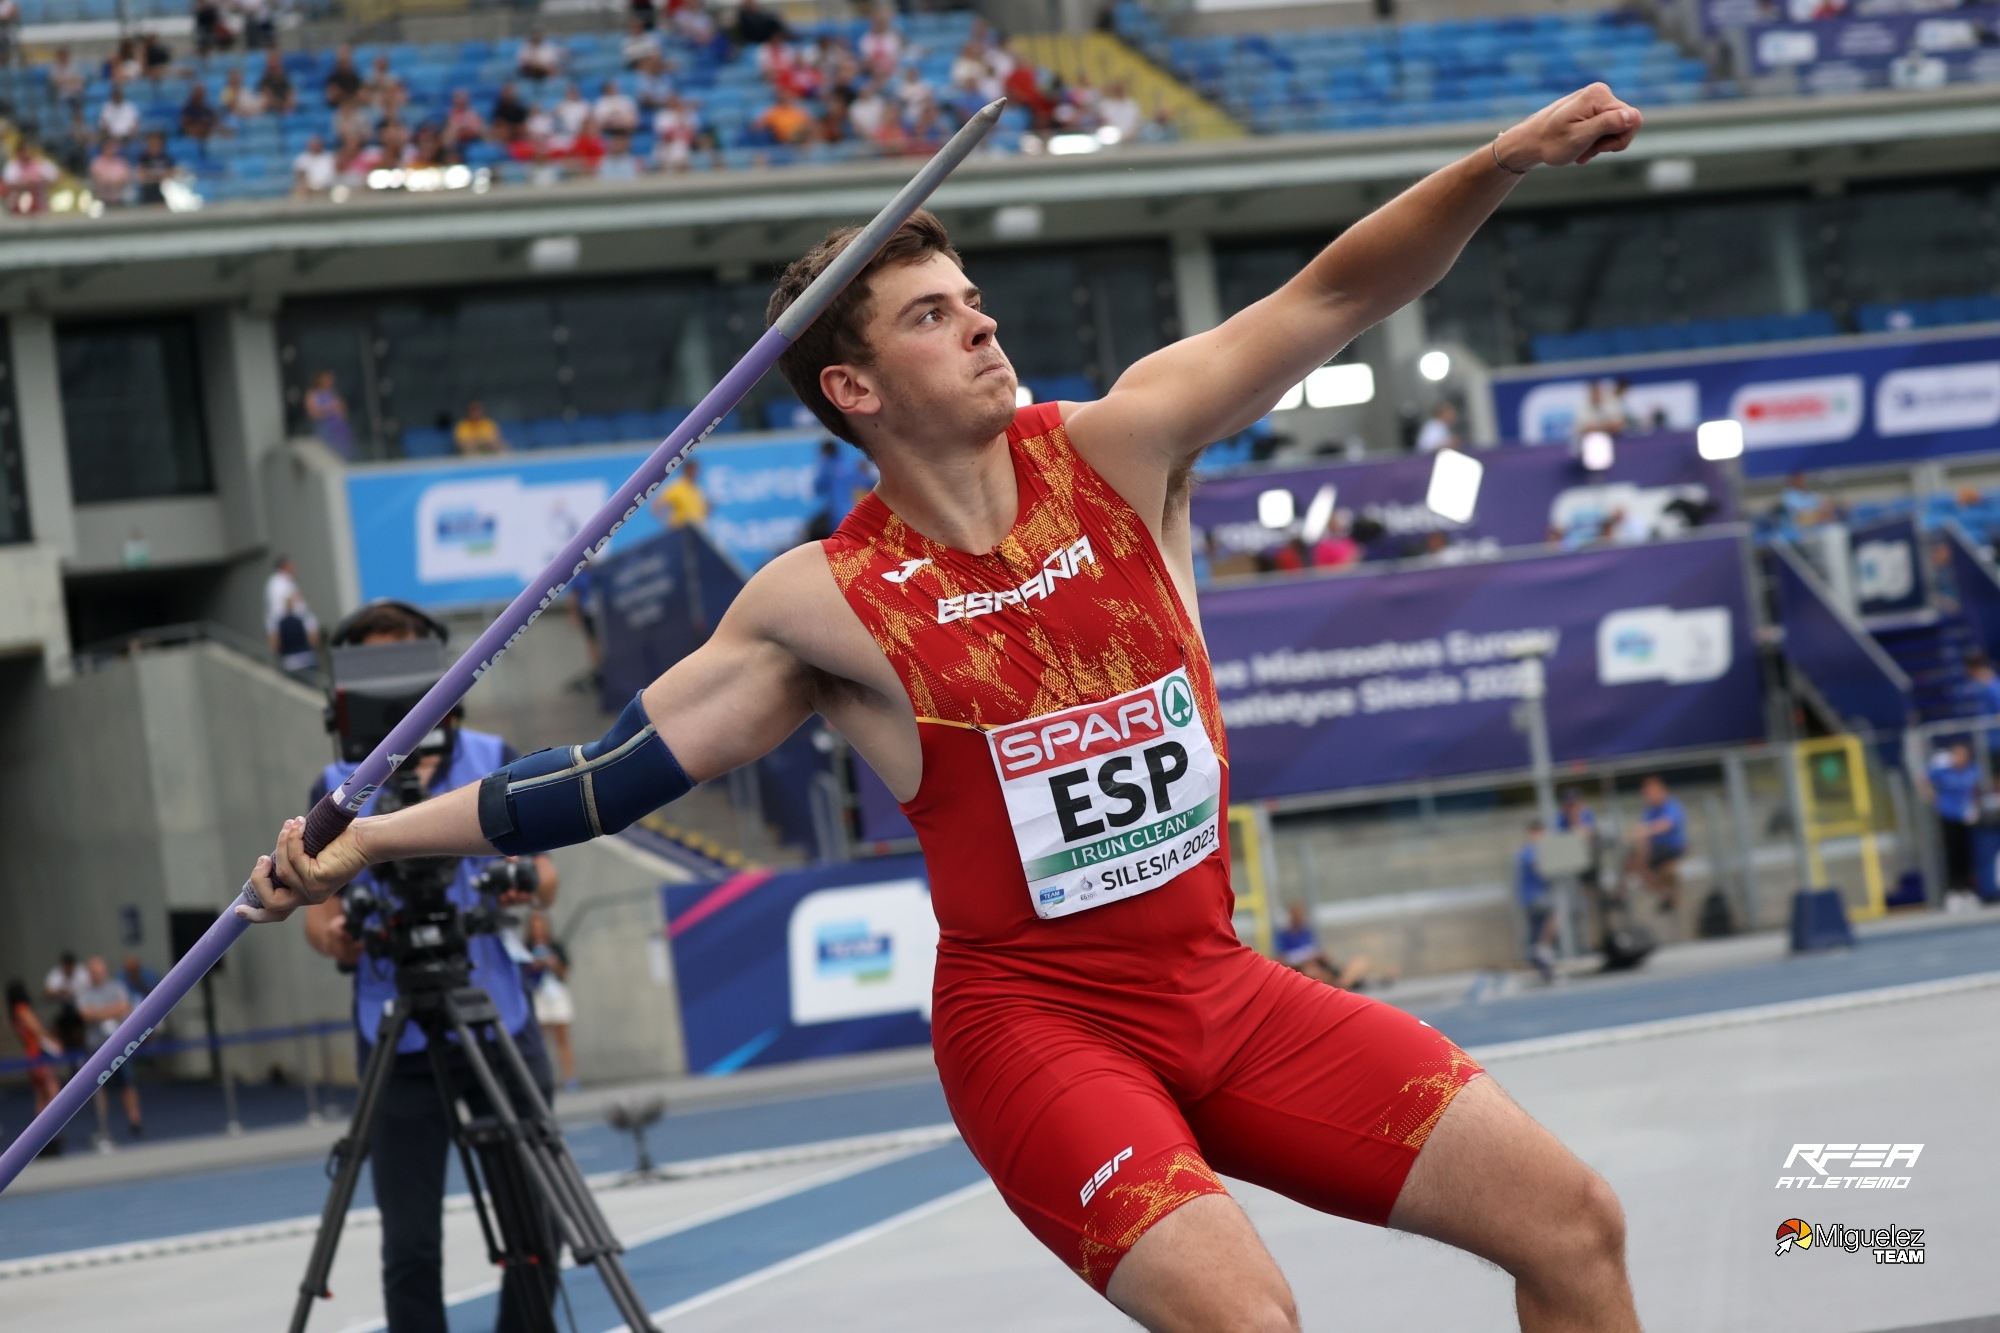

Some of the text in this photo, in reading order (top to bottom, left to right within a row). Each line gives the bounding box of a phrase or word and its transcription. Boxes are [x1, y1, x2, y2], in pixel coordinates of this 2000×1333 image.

[937, 534, 1096, 625] ESPAÑA
[1000, 698, 1160, 772] SPAR
[1048, 741, 1190, 843] ESP
[1071, 851, 1078, 867] I
[1082, 839, 1127, 864] RUN
[1101, 824, 1215, 891] SILESIA 2023
[1079, 1146, 1134, 1208] ESP
